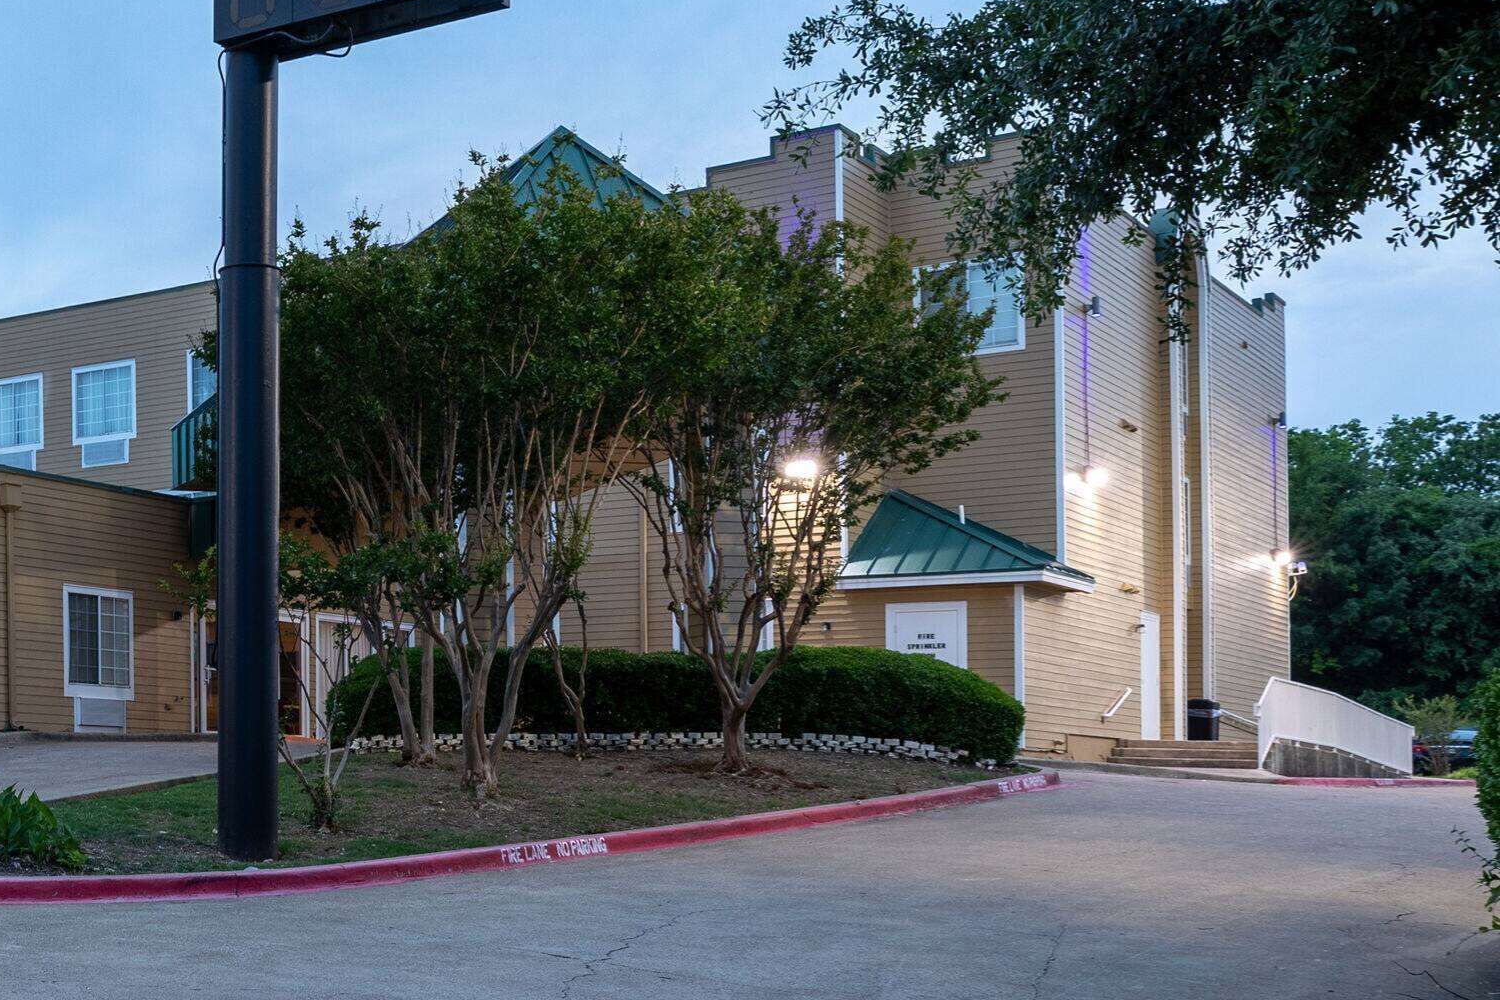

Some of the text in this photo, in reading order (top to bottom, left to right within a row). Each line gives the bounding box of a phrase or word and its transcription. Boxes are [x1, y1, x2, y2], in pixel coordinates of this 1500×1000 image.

[907, 642, 946, 650] SPRINKLER
[500, 836, 608, 864] FIRE LANE NO PARKING
